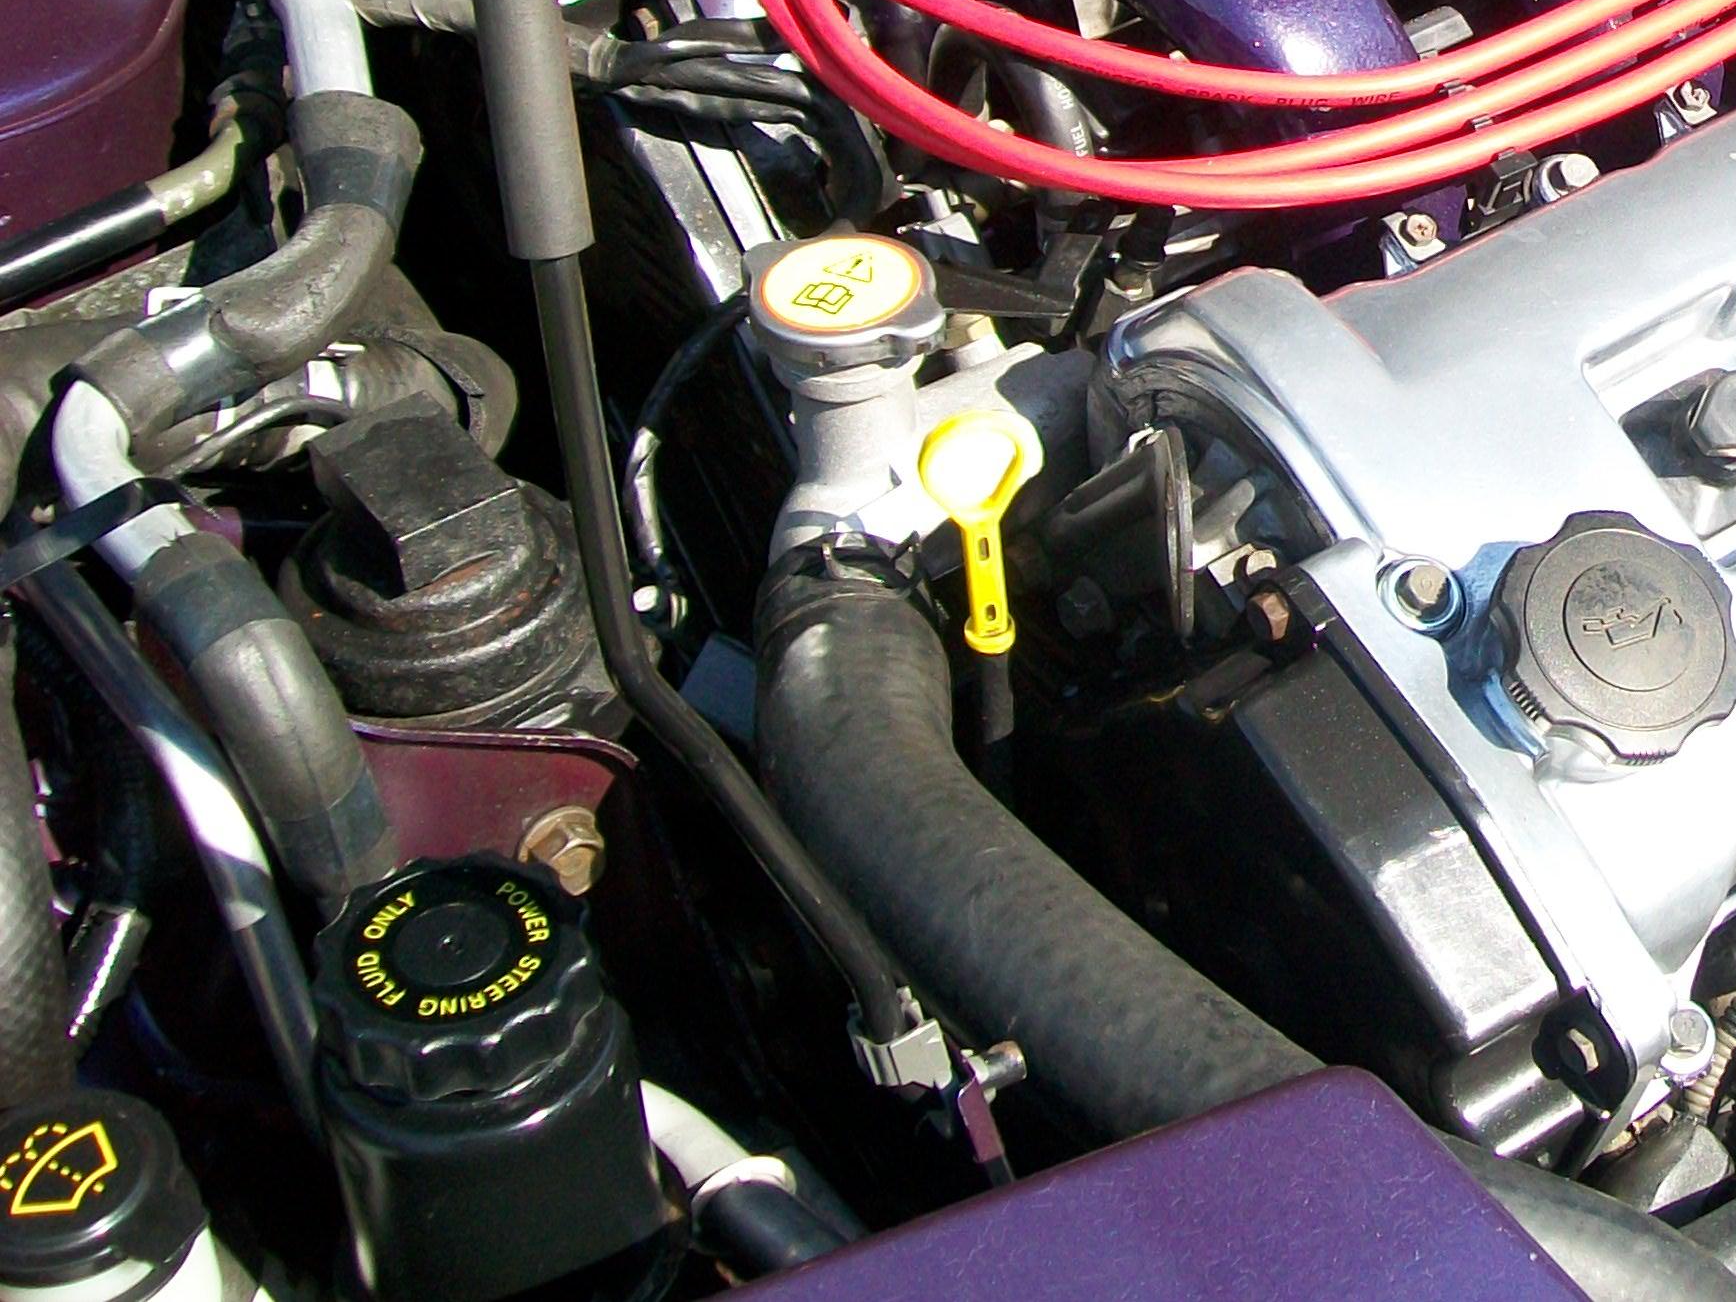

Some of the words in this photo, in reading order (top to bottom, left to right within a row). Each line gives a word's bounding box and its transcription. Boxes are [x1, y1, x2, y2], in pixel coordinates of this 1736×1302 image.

[1053, 79, 1075, 110] HOS
[1070, 120, 1088, 158] FUEL
[362, 890, 417, 941] ONLY
[496, 880, 550, 944] POWER
[356, 949, 407, 1007] FLUID
[417, 954, 542, 1018] STEERING
